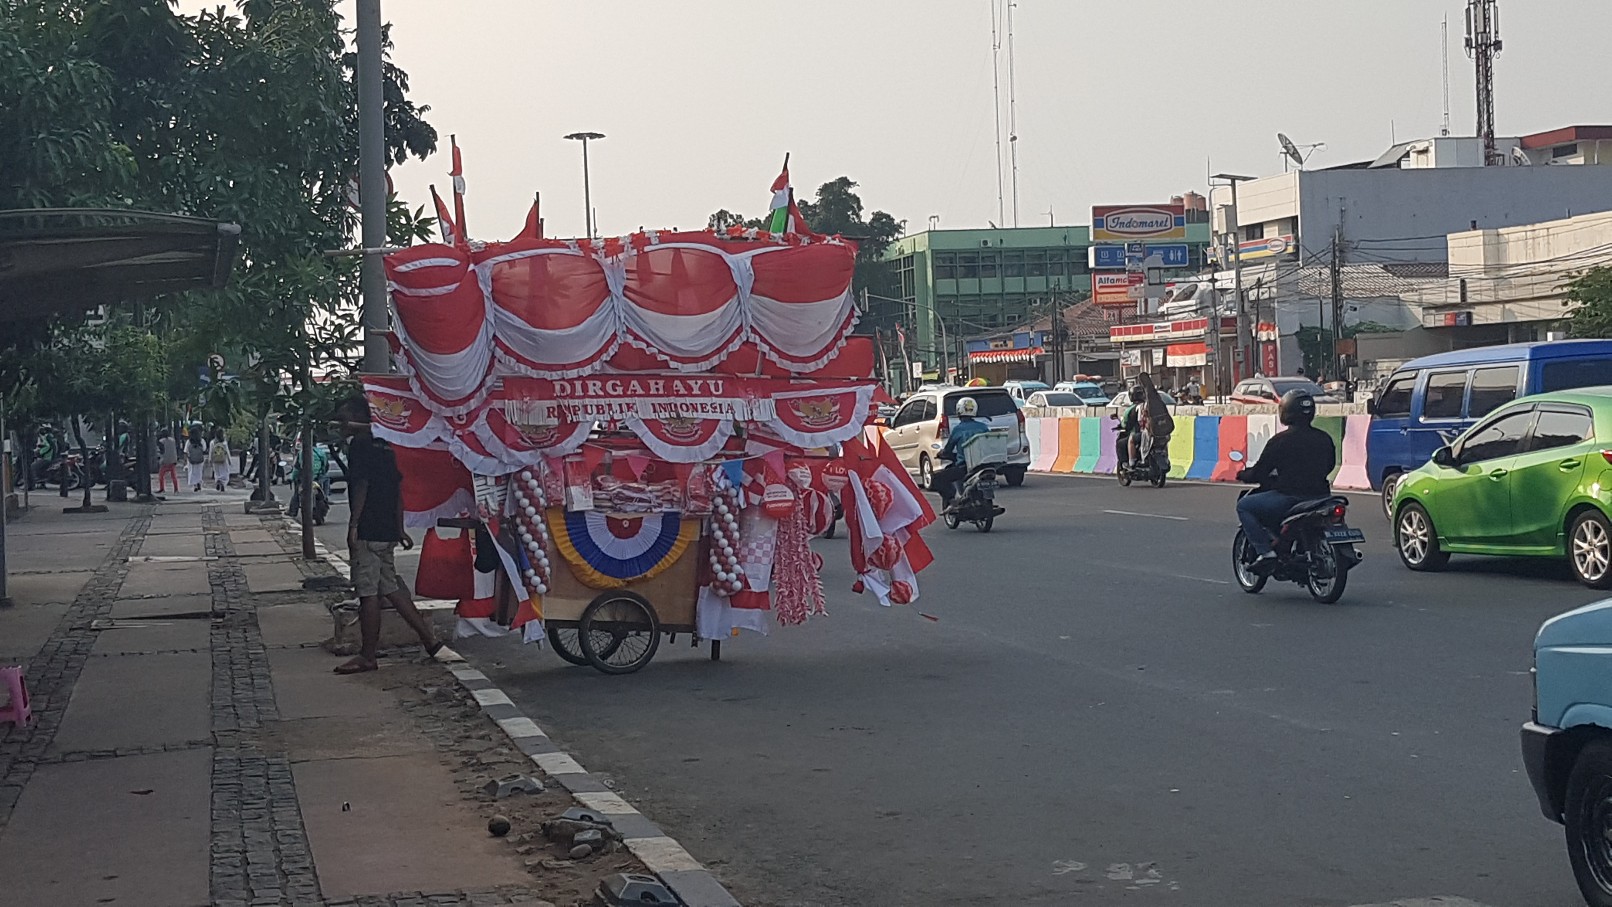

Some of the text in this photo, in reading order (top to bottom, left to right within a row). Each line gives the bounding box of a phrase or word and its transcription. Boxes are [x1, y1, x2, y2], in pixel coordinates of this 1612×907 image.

[1109, 217, 1168, 229] Indomaret
[1098, 276, 1127, 285] Alfama
[553, 379, 724, 397] DIRGAHAYU
[652, 402, 735, 415] INDONESIA
